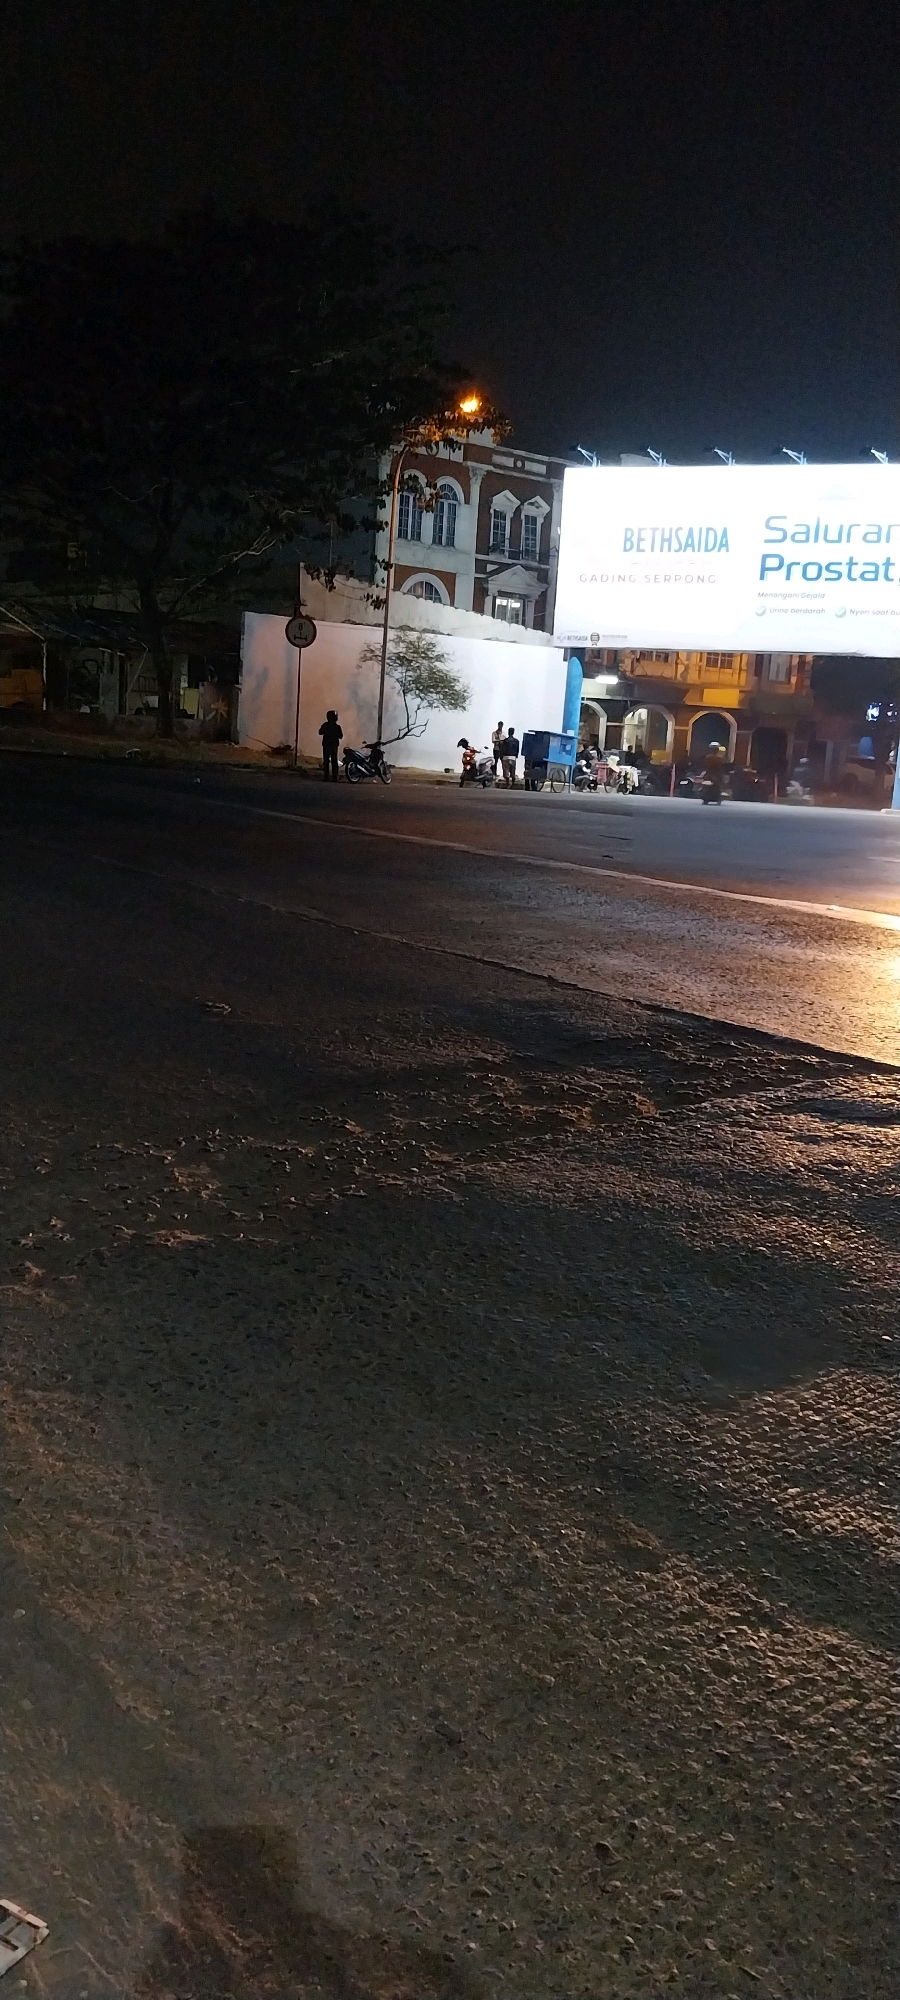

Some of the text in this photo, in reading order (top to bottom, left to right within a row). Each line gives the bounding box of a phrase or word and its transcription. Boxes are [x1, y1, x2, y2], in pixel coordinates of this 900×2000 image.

[622, 526, 730, 553] BETHSAIDA
[579, 573, 717, 584] GADING SERPONG
[757, 591, 826, 600] Menangani Gejala
[790, 607, 826, 615] berdarah
[849, 608, 871, 617] Nyeri
[871, 608, 889, 616] saat
